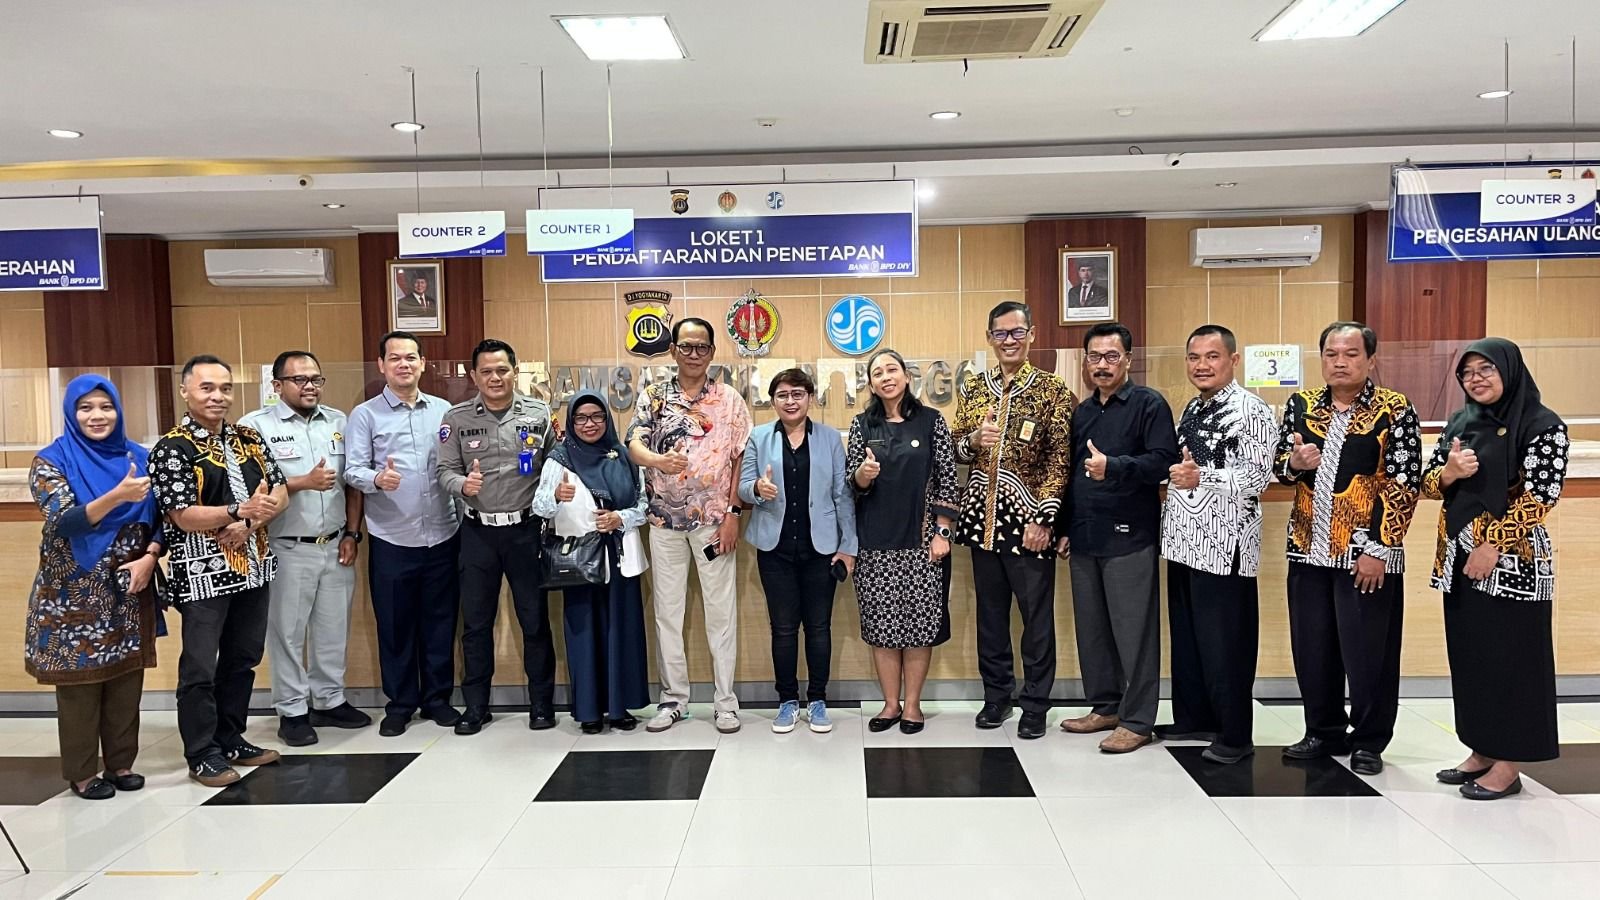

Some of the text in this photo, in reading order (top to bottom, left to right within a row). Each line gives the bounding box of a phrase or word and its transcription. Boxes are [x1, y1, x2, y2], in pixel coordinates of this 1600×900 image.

[1496, 194, 1575, 204] COUNTER 3
[412, 226, 486, 237] COUNTER 2
[540, 224, 611, 234] COUNTER 1
[1413, 226, 1538, 245] PENGESAHAN
[691, 230, 764, 246] LOKET 1
[573, 244, 885, 266] PENDAFTARAN DAN PENETAPAN
[1267, 359, 1278, 376] 3
